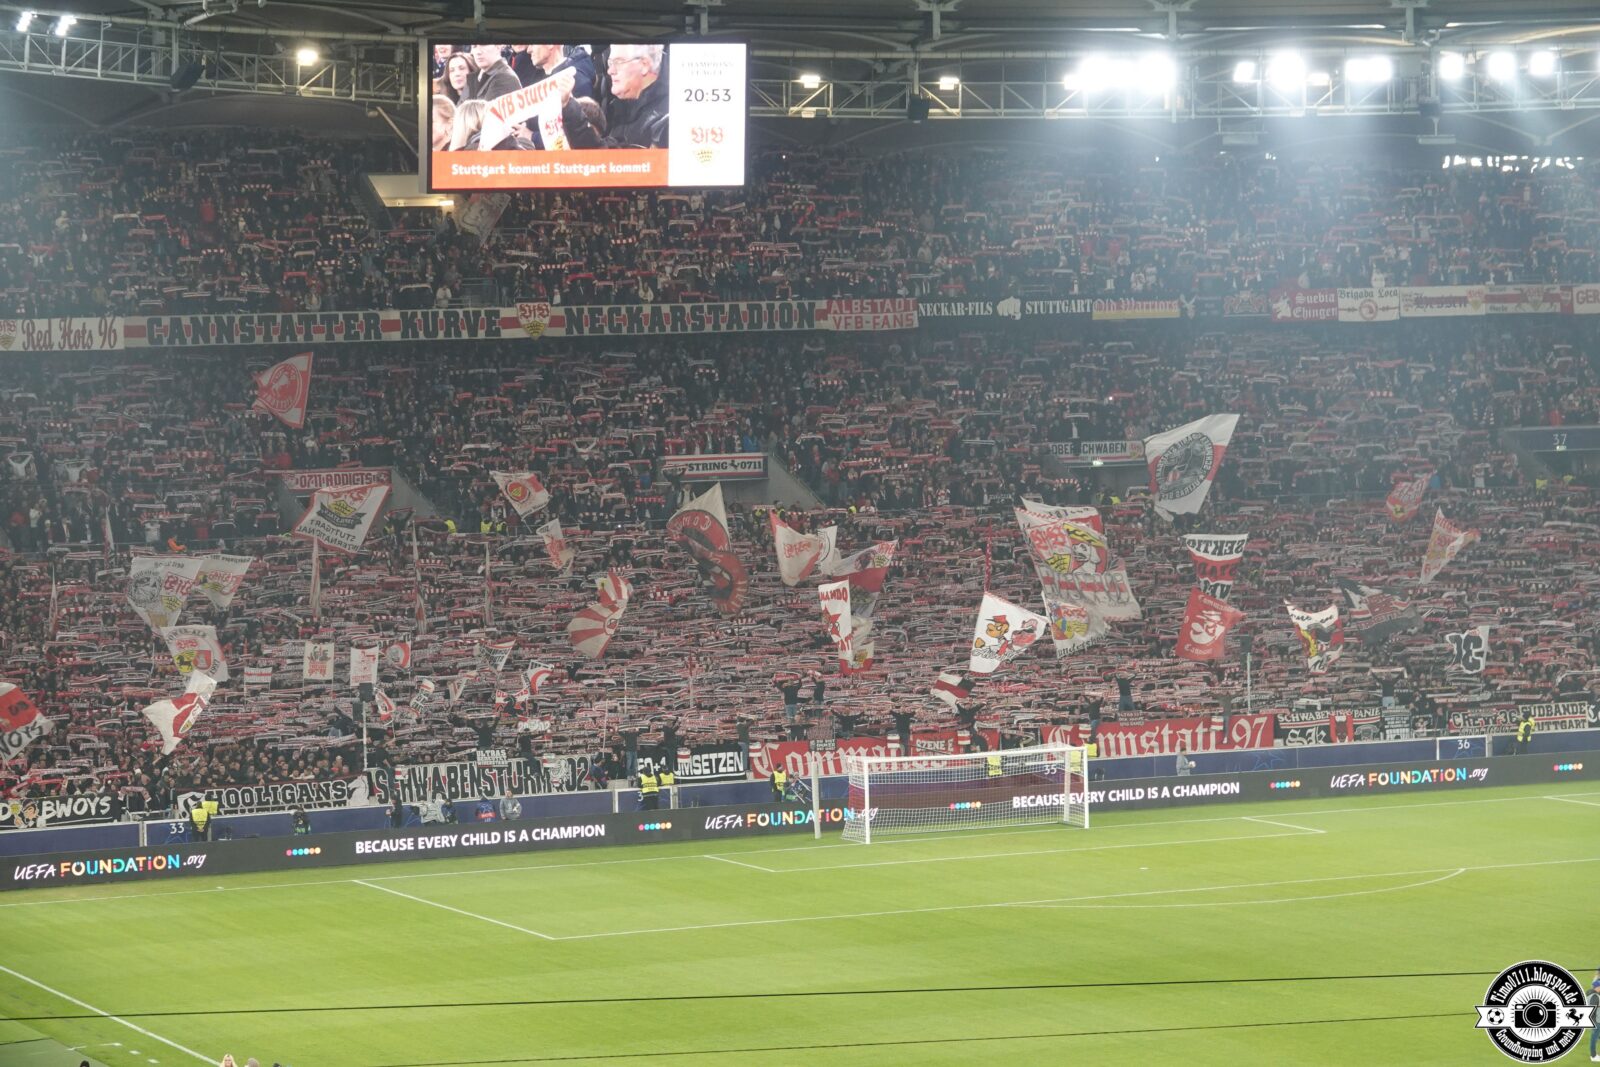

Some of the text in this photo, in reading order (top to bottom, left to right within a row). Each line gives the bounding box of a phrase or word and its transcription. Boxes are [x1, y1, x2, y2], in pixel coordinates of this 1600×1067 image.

[684, 88, 732, 102] 20:53
[451, 161, 651, 177] Stuttgart kommt! Stuttgart kommt!
[829, 299, 915, 314] ALBSTADT
[918, 299, 1093, 317] NECKAR-FILS STUTTGART
[147, 302, 816, 348] CANNSTATTER KURVE NECKARSTADION
[832, 312, 914, 330] VFB-FANS
[21, 316, 117, 350] Red Hots 96
[1552, 434, 1567, 446] 37
[687, 461, 762, 473] STRING 0711
[1231, 716, 1267, 751] 97
[1537, 719, 1586, 731] UTTGART
[1457, 740, 1470, 750] 36
[565, 757, 590, 793] 02
[1330, 768, 1489, 789] UEFA FOUNDATION .org
[204, 780, 348, 809] HOOLIGANS
[1012, 795, 1065, 809] BECAUSE
[1108, 787, 1145, 803] CHILD
[1147, 786, 1158, 800] IS
[1160, 785, 1170, 799] A
[1172, 781, 1240, 798] CHAMPION
[41, 796, 112, 820] BWOYS
[704, 814, 744, 830] UEFA
[746, 807, 855, 828] FOUNDATION
[169, 823, 184, 834] 33
[355, 824, 605, 854] BECAUSE EVERY CHILD IS A CHAMPION
[13, 853, 207, 882] UEFA FOUNDATION .org
